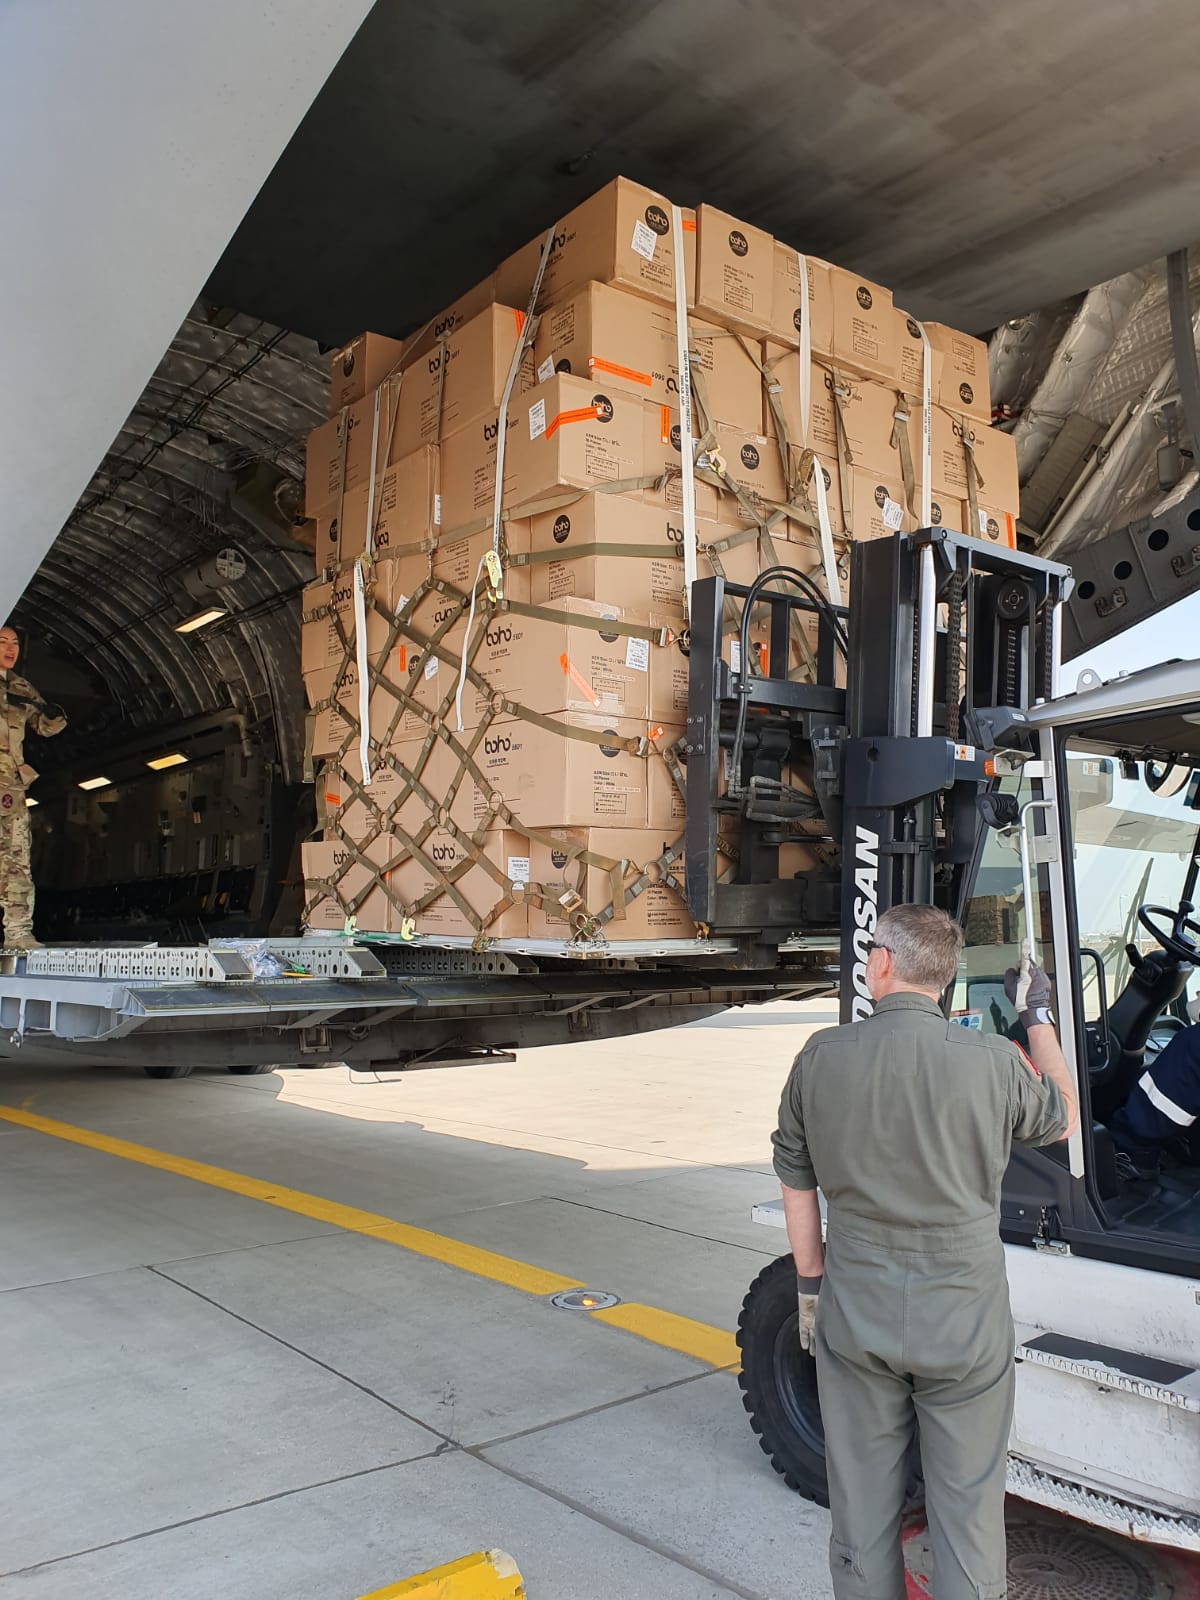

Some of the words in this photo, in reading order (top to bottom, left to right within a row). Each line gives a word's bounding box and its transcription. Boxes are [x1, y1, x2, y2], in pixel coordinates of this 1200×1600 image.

[486, 626, 511, 647] boho
[485, 735, 511, 754] boho
[433, 843, 455, 860] boho
